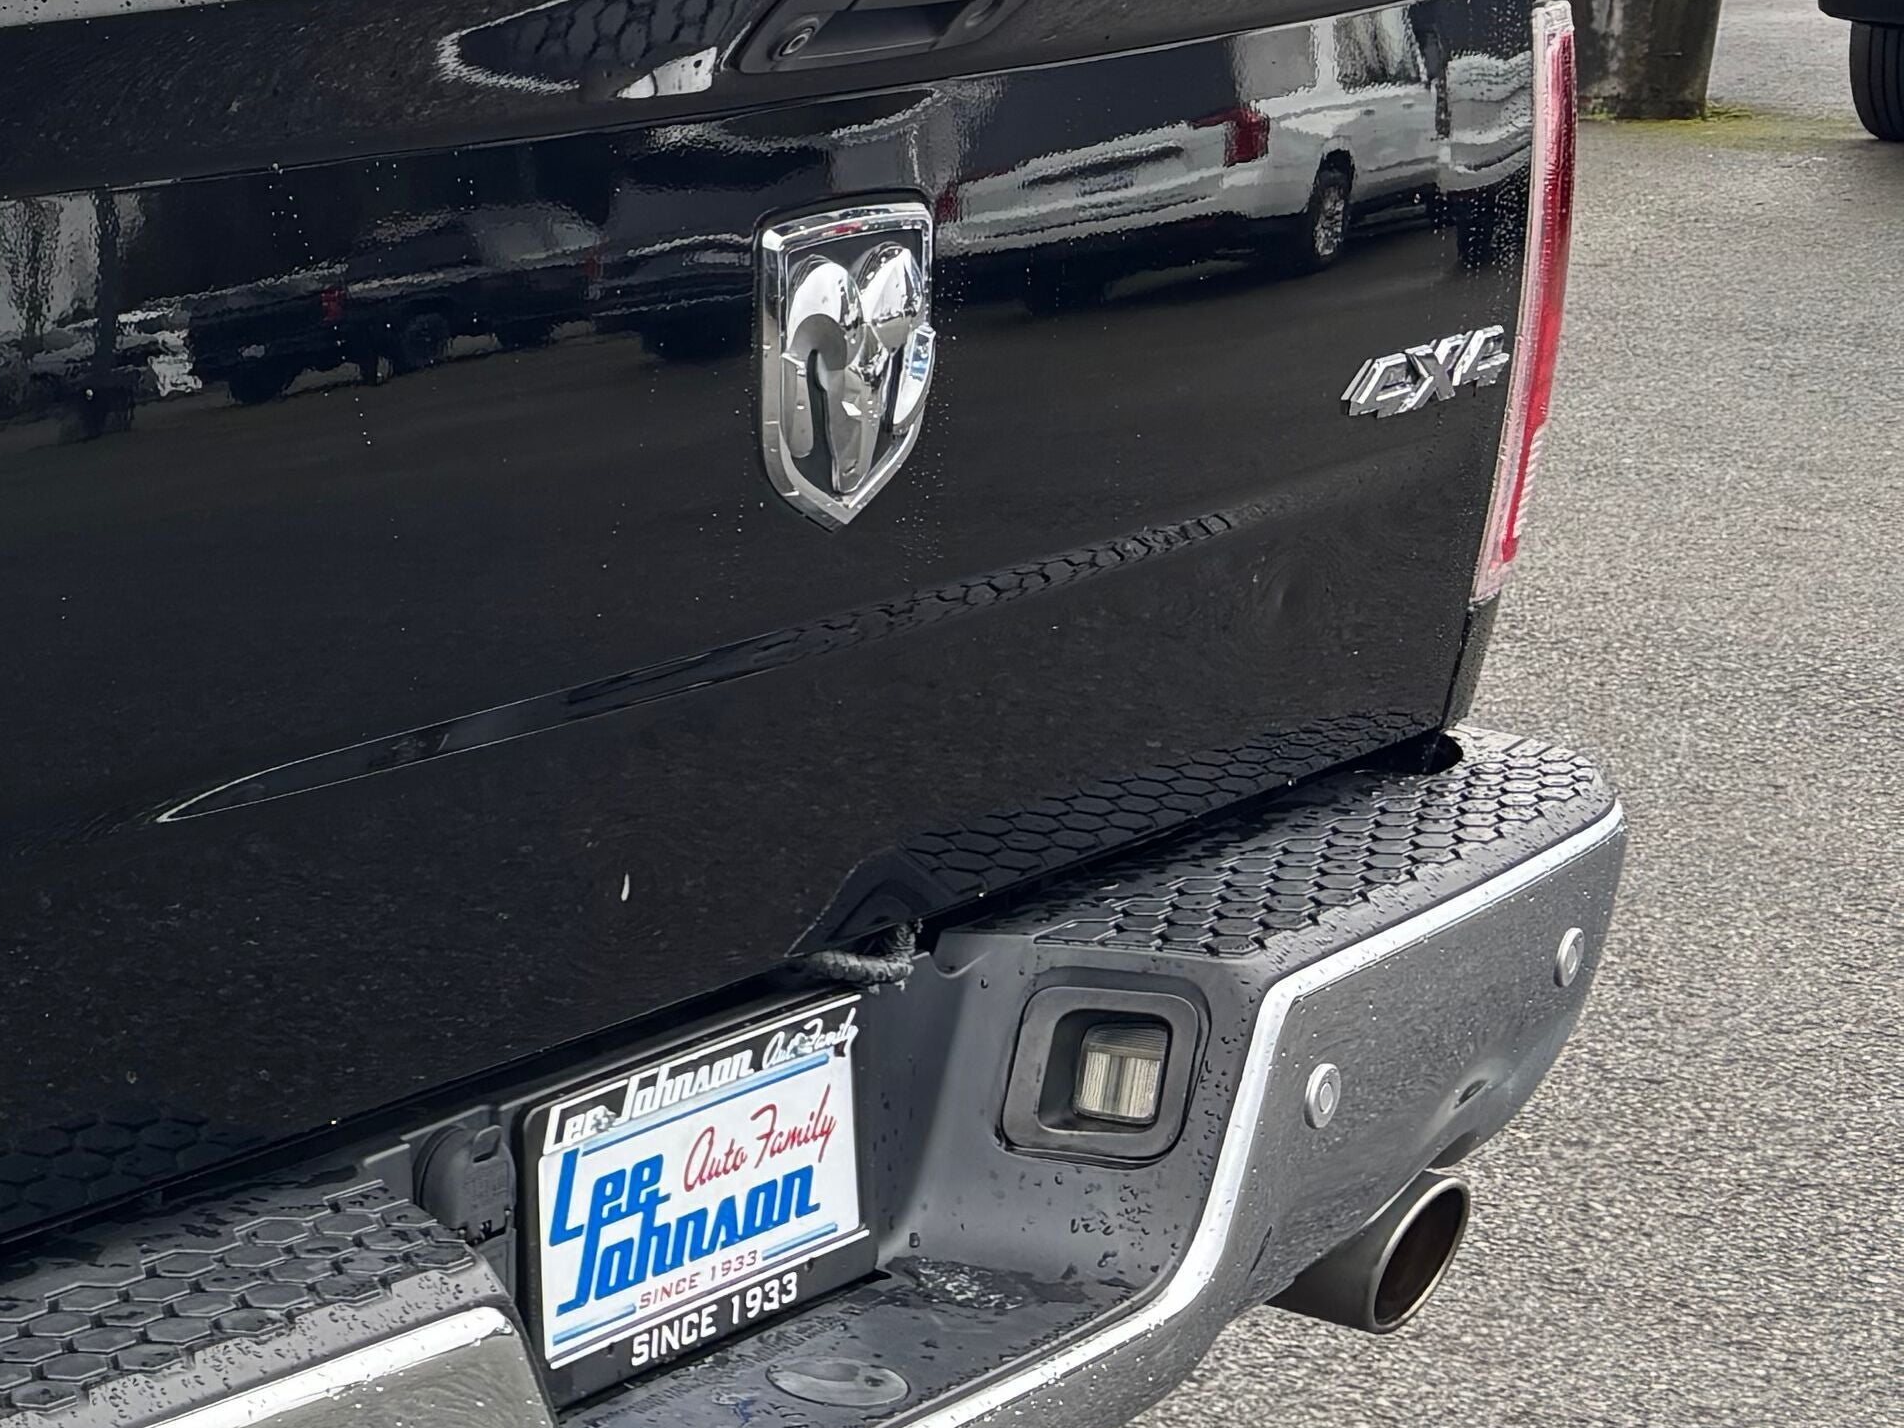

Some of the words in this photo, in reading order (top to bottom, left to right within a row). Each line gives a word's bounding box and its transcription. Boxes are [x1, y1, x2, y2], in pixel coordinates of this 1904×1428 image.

[610, 1048, 755, 1128] Johnson
[762, 1031, 810, 1070] Aut
[683, 1125, 748, 1193] Auto
[750, 1083, 838, 1163] Family
[549, 1147, 667, 1247] Lee
[556, 1164, 821, 1317] Johnson
[631, 1305, 718, 1368] SINCE
[731, 1272, 799, 1326] 1933
[638, 1273, 702, 1311] SINCE
[710, 1250, 758, 1283] 1933
